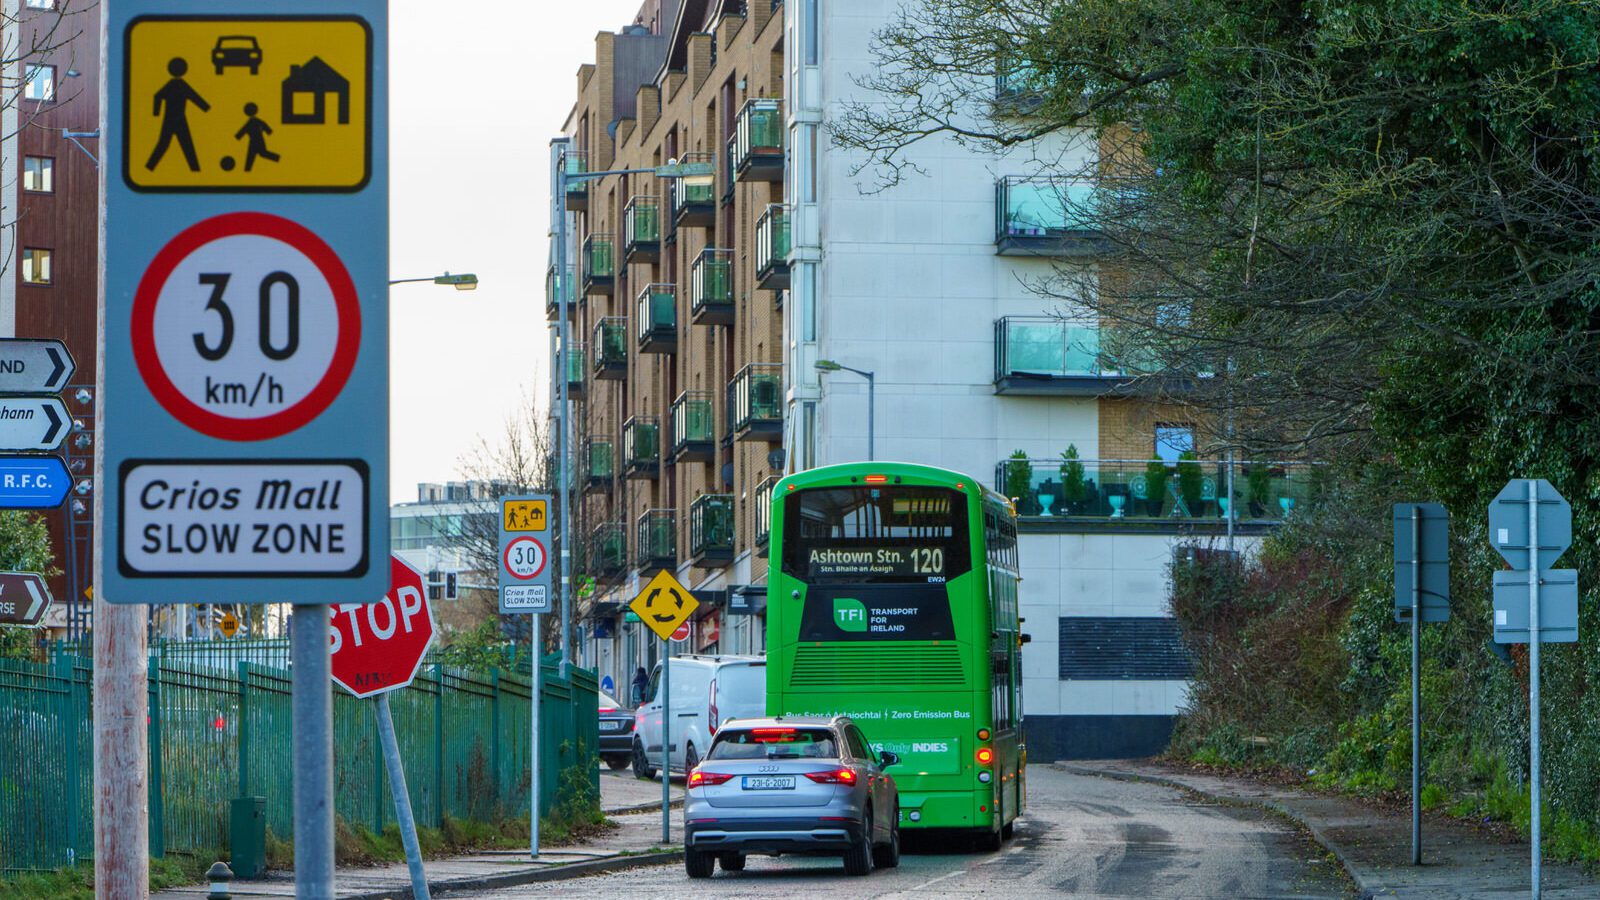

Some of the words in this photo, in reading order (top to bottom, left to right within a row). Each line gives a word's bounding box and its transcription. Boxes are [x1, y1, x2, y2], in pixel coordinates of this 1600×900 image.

[192, 271, 300, 361] 30
[205, 372, 284, 407] km/h
[0, 405, 34, 420] hann
[4, 474, 52, 488] R.F.C.
[140, 480, 241, 510] Crios
[255, 480, 342, 510] Mall
[141, 523, 241, 554] SLOW
[252, 523, 345, 554] ZONE
[515, 547, 535, 565] 30
[809, 549, 873, 563] Ashtown
[877, 549, 904, 563] Stn.
[910, 548, 943, 573] 120
[838, 609, 863, 621] TFI
[891, 710, 912, 719] Zero
[913, 710, 951, 719] Emission
[953, 710, 971, 719] Bus
[912, 742, 948, 753] INDIES
